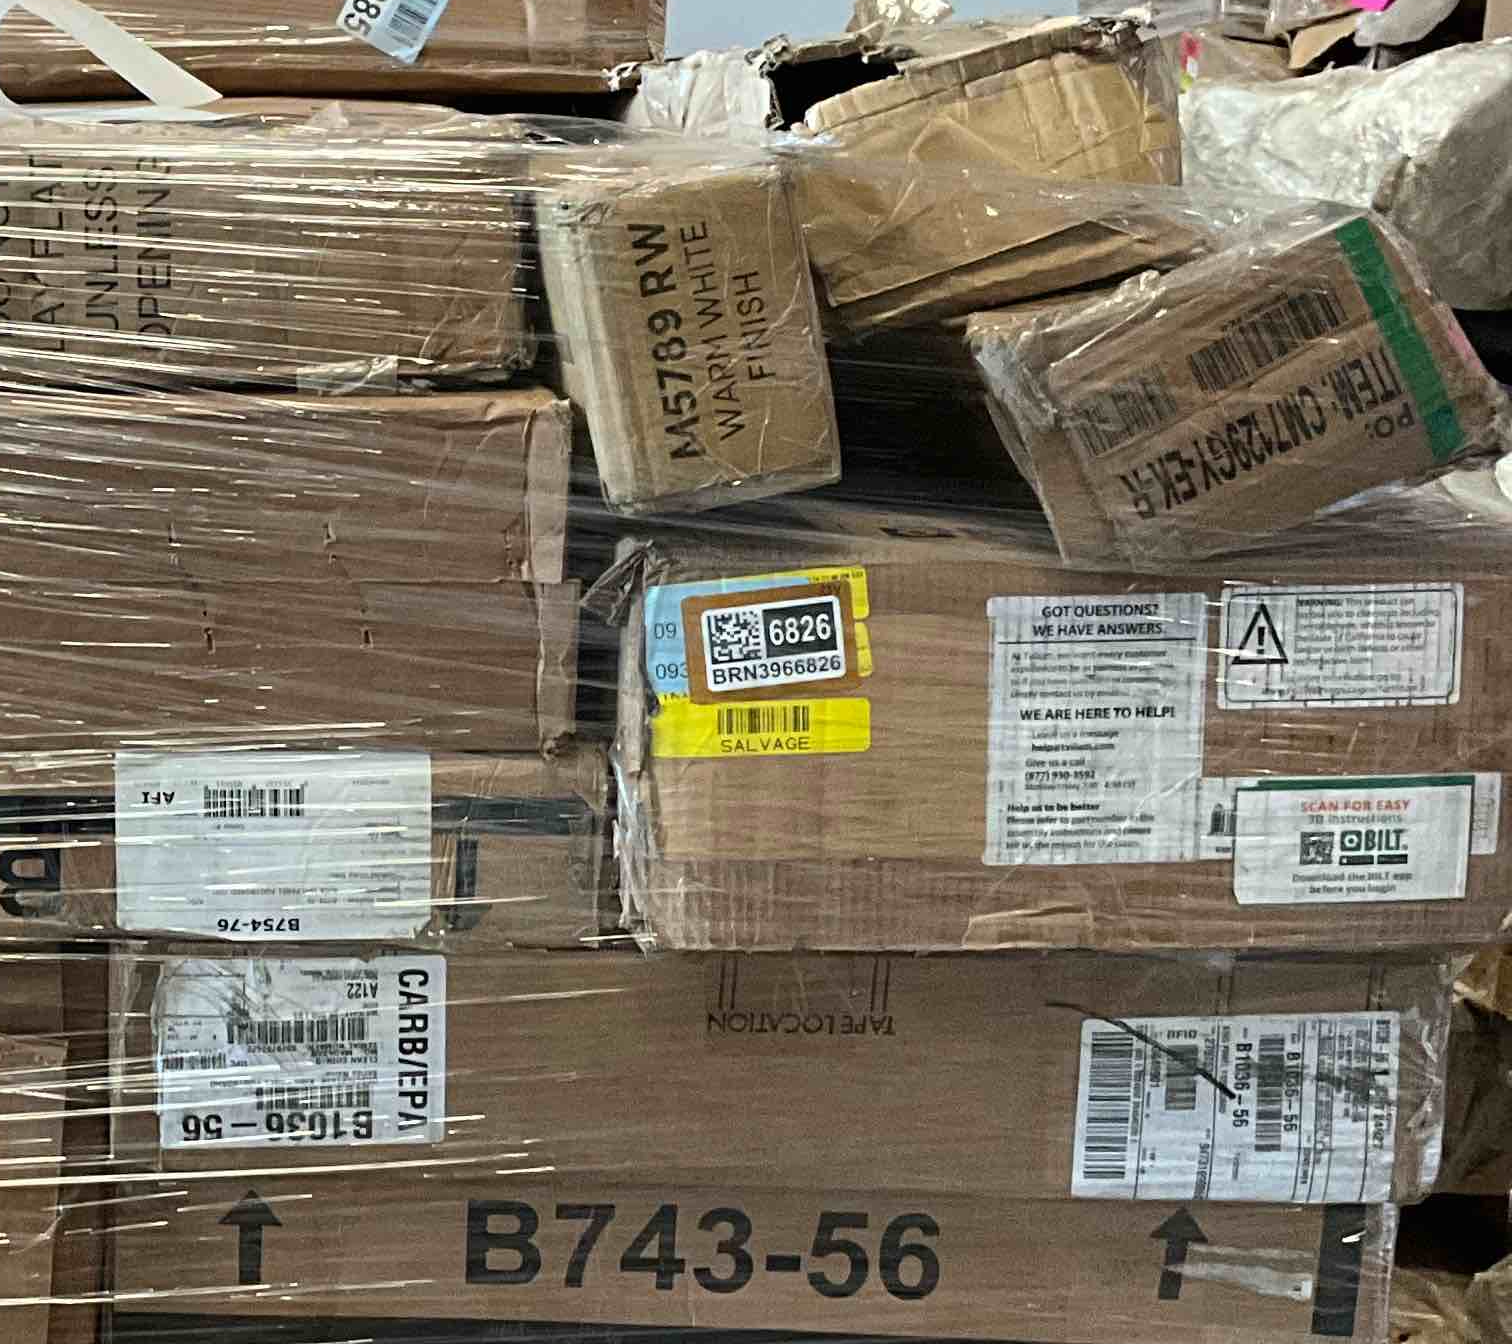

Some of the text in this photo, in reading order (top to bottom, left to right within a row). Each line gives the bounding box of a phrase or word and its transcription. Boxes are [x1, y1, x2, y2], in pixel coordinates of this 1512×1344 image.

[679, 220, 747, 443] WARM WHITE
[731, 269, 777, 383] FINISH
[626, 221, 707, 462] M5789 RW
[1041, 603, 1161, 620] GOT QUESTIONS?
[768, 612, 832, 647] 6826
[1032, 623, 1054, 638] WE
[1057, 623, 1094, 637] HAVE
[711, 654, 842, 687] BRN3966826
[1020, 709, 1041, 722] WE
[1045, 708, 1071, 721] ARE
[1075, 708, 1110, 720] HERE
[1113, 707, 1132, 719] TO
[720, 736, 812, 754] SALVAGE
[140, 791, 176, 805] AFI
[1301, 799, 1411, 812] SCAN FOR EASY
[1364, 828, 1407, 852] BILT
[216, 917, 301, 933] B754-76
[346, 981, 379, 1000] A122
[705, 1010, 897, 1037] TAPE LOCATION
[396, 967, 430, 1132] CARB/EPA
[463, 1198, 943, 1302] B743-56
